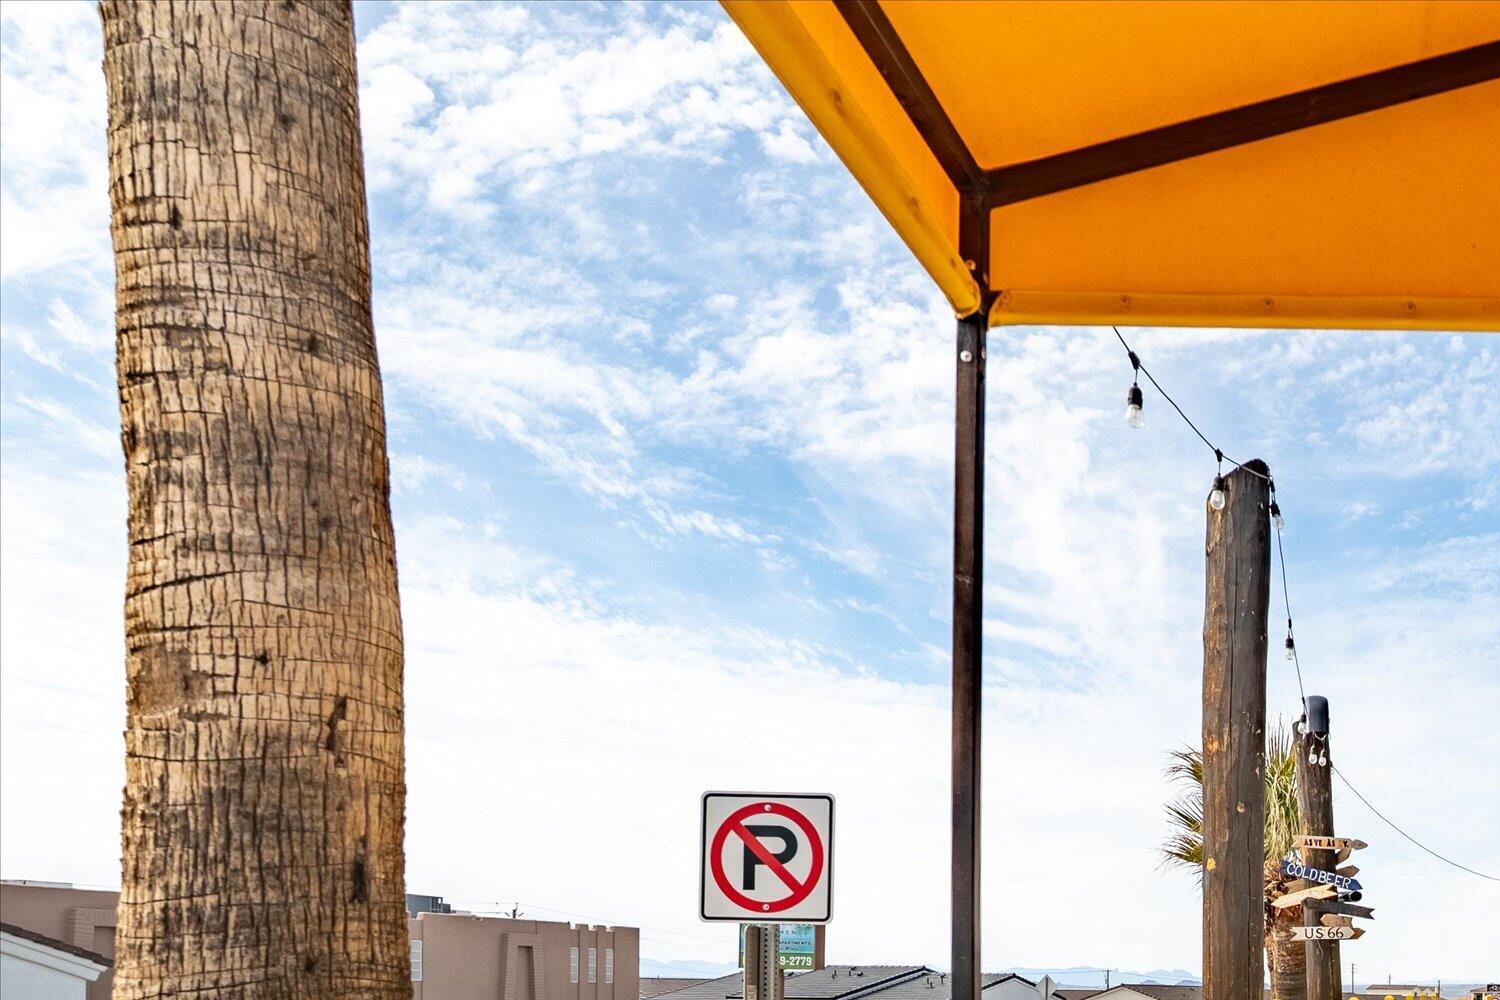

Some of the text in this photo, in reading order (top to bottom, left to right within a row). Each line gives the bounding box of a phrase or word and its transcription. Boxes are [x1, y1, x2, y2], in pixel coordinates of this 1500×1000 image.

[743, 825, 798, 890] P
[1304, 927, 1344, 939] US 66
